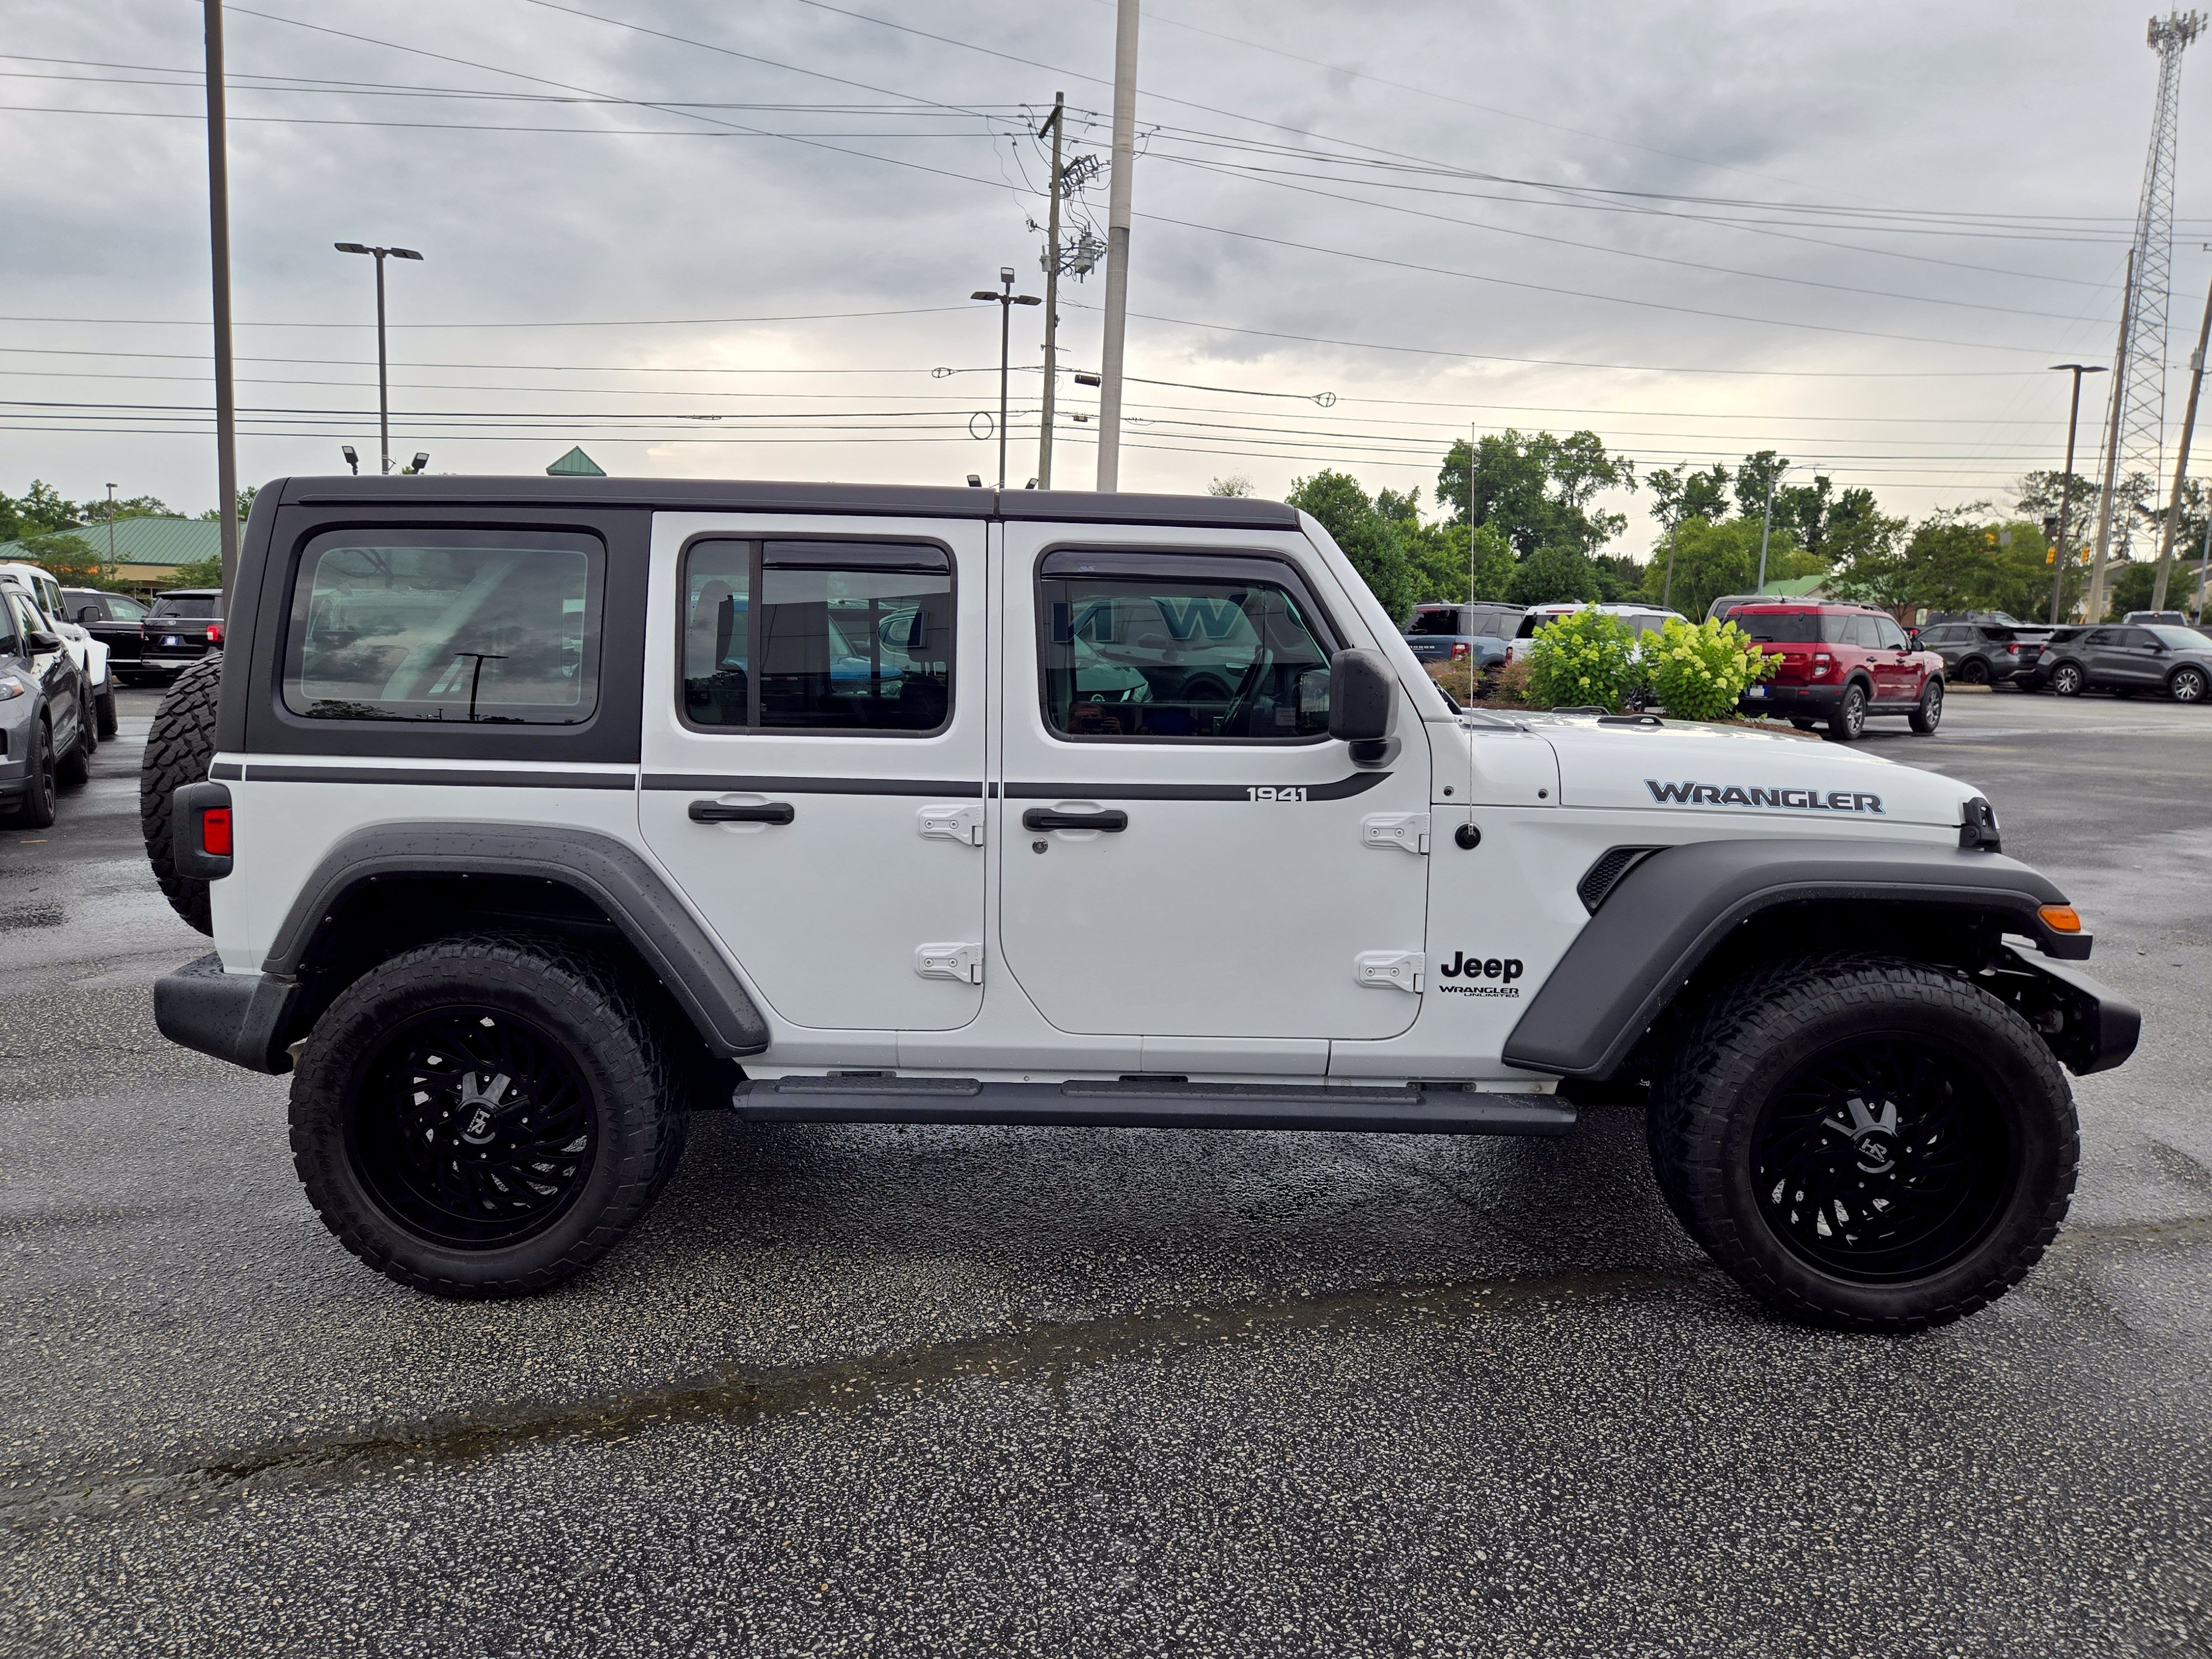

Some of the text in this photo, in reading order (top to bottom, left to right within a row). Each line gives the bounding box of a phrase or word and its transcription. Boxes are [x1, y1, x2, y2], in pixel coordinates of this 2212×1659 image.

[1246, 787, 1307, 802] 1941
[1644, 779, 1886, 815] WRANGLER
[1441, 951, 1524, 984] Jeep
[1438, 985, 1520, 995] WRANGLER
